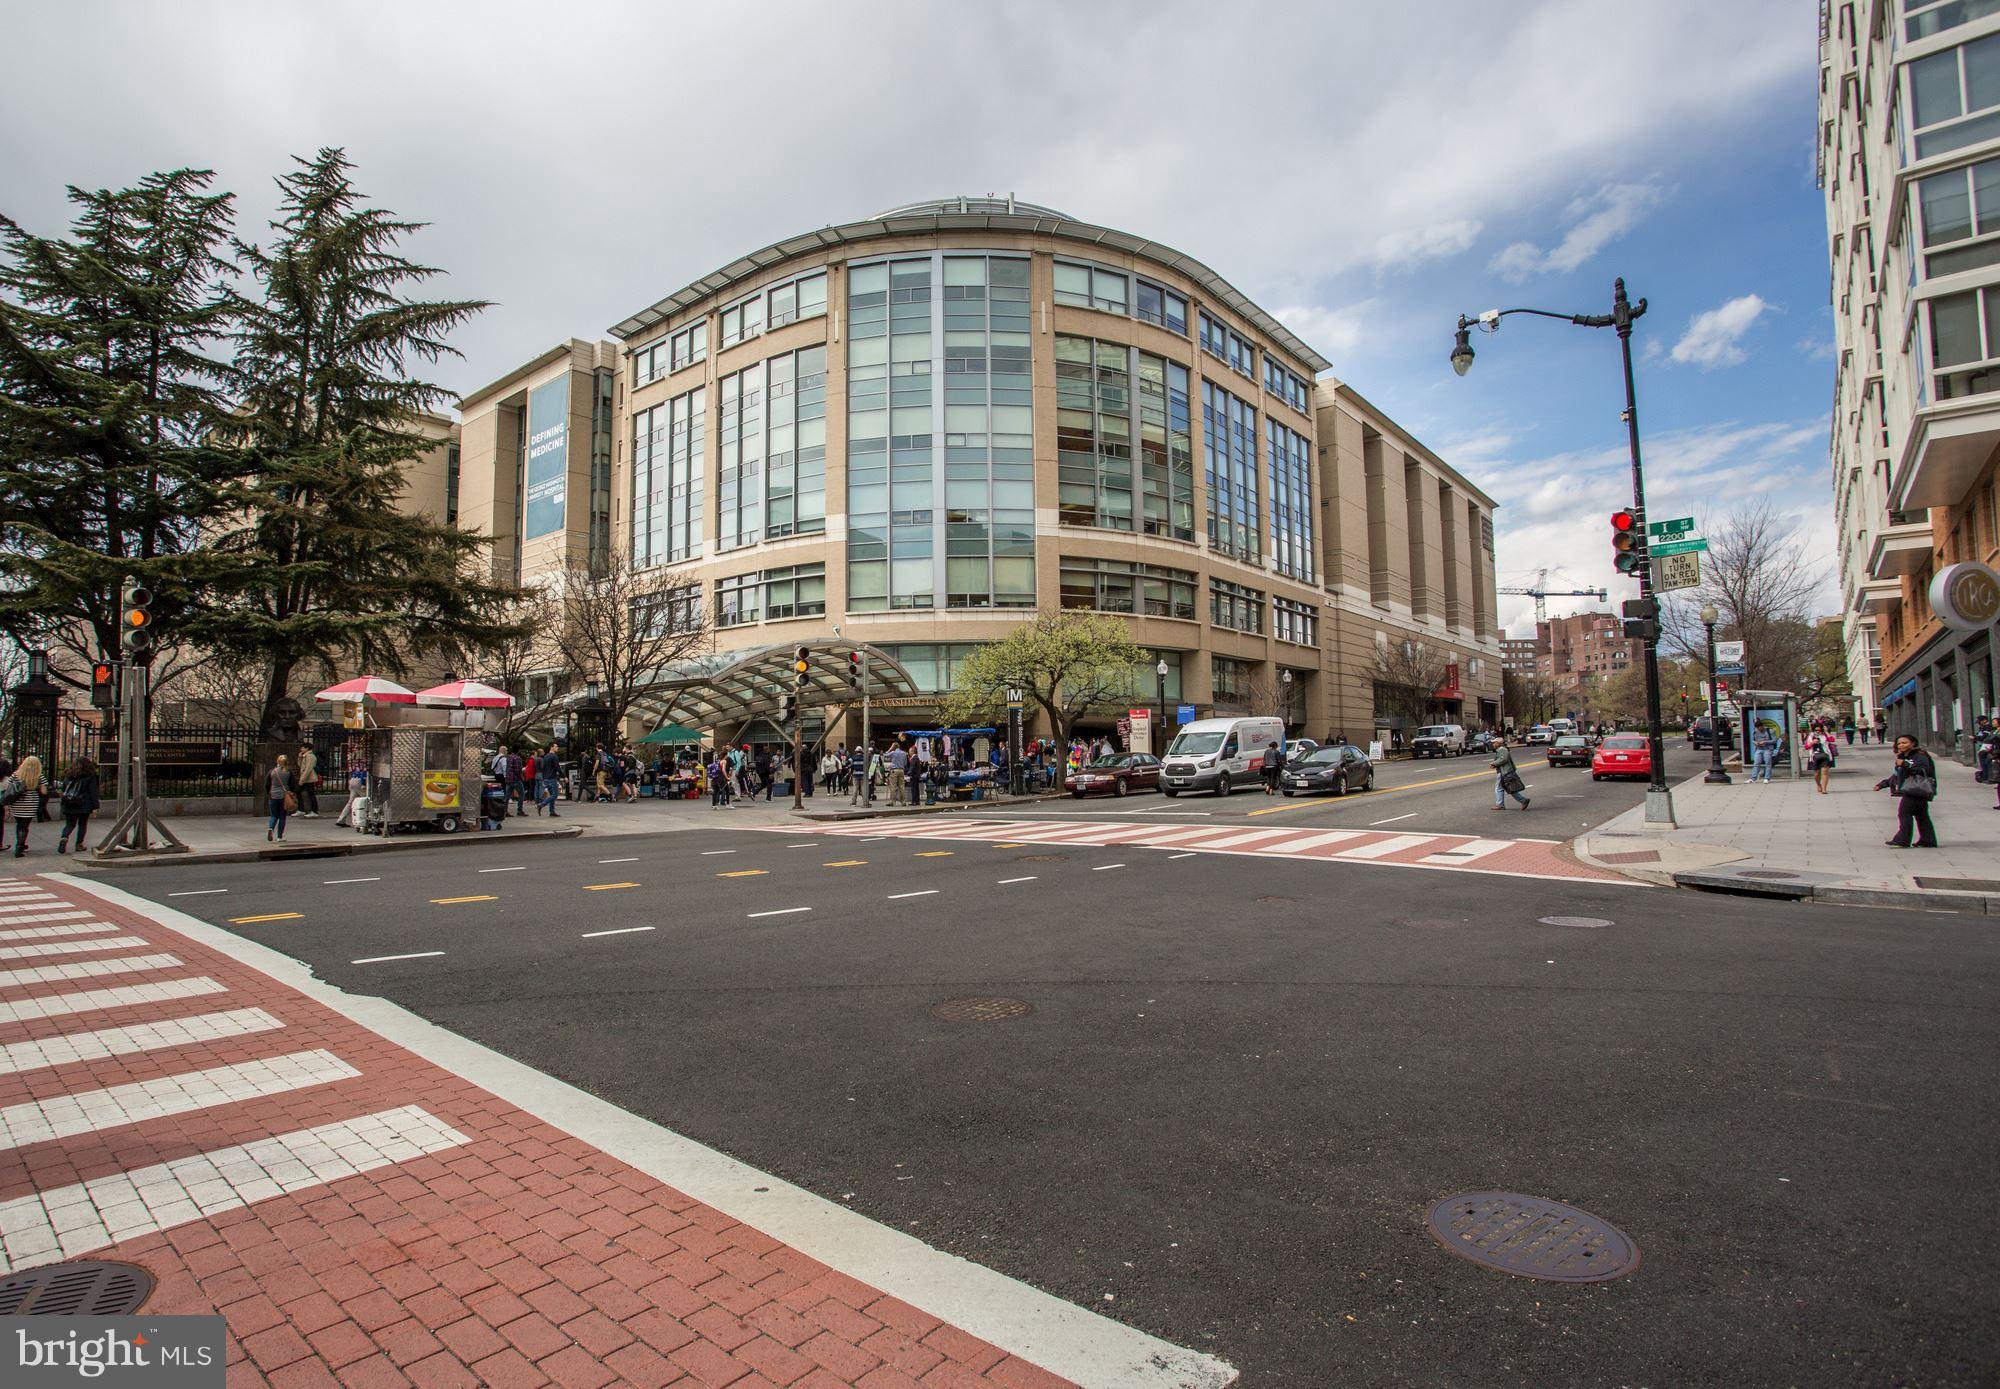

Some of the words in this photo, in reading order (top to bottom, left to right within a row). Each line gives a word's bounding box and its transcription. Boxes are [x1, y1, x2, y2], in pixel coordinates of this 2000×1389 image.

[531, 422, 564, 446] DEFINING
[530, 436, 564, 459] MEDICINE
[1662, 522, 1669, 534] I
[1659, 532, 1684, 542] 2200
[1672, 556, 1686, 564] NO
[1669, 562, 1691, 572] TURN
[1679, 569, 1696, 578] RED
[1664, 577, 1697, 588] 7AM-7PM
[1010, 689, 1022, 701] M
[882, 697, 948, 707] WASHINGTON
